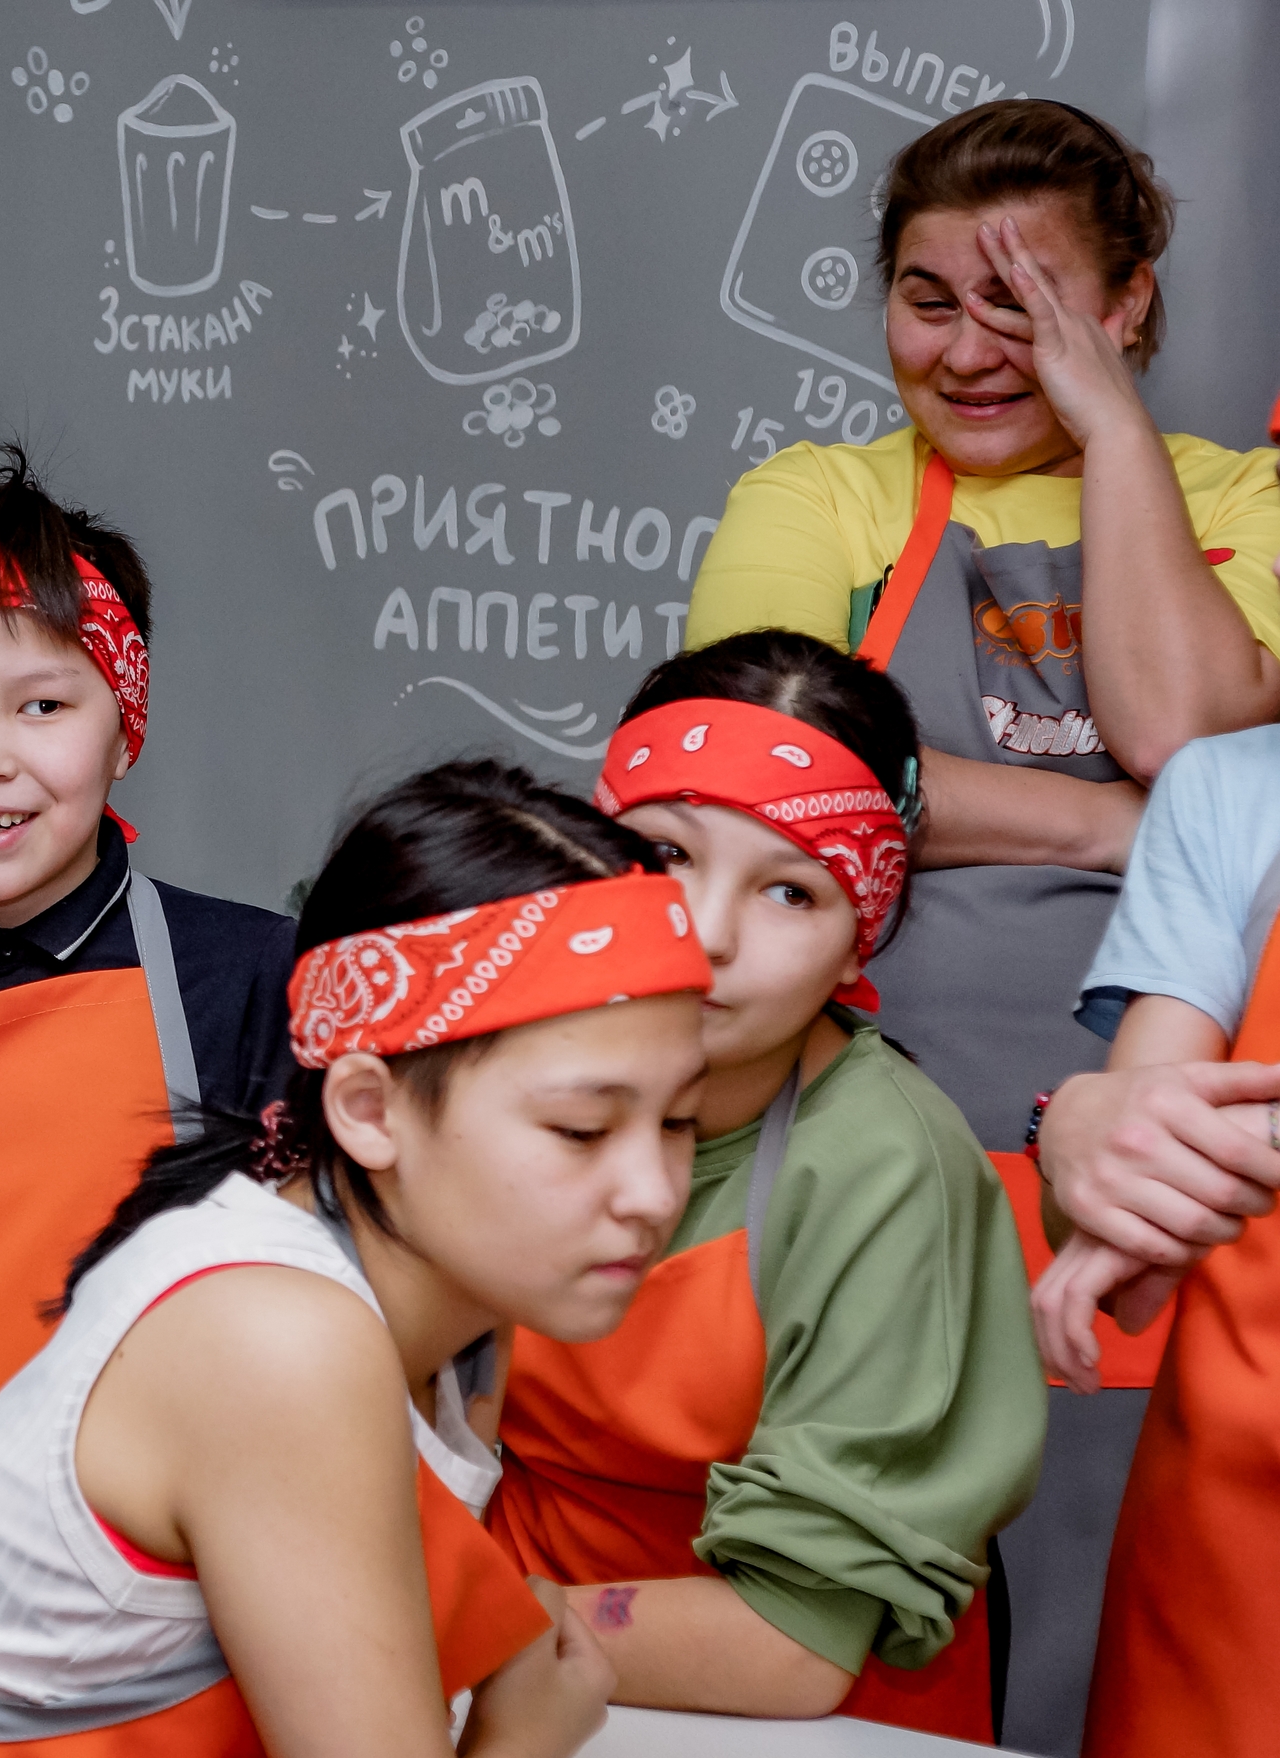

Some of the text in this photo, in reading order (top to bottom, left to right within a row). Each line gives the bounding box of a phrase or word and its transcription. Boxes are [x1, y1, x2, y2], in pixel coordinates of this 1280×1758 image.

[829, 21, 1028, 114] ВЫПЕК
[127, 365, 232, 404] МУКИ
[731, 406, 785, 466] 15
